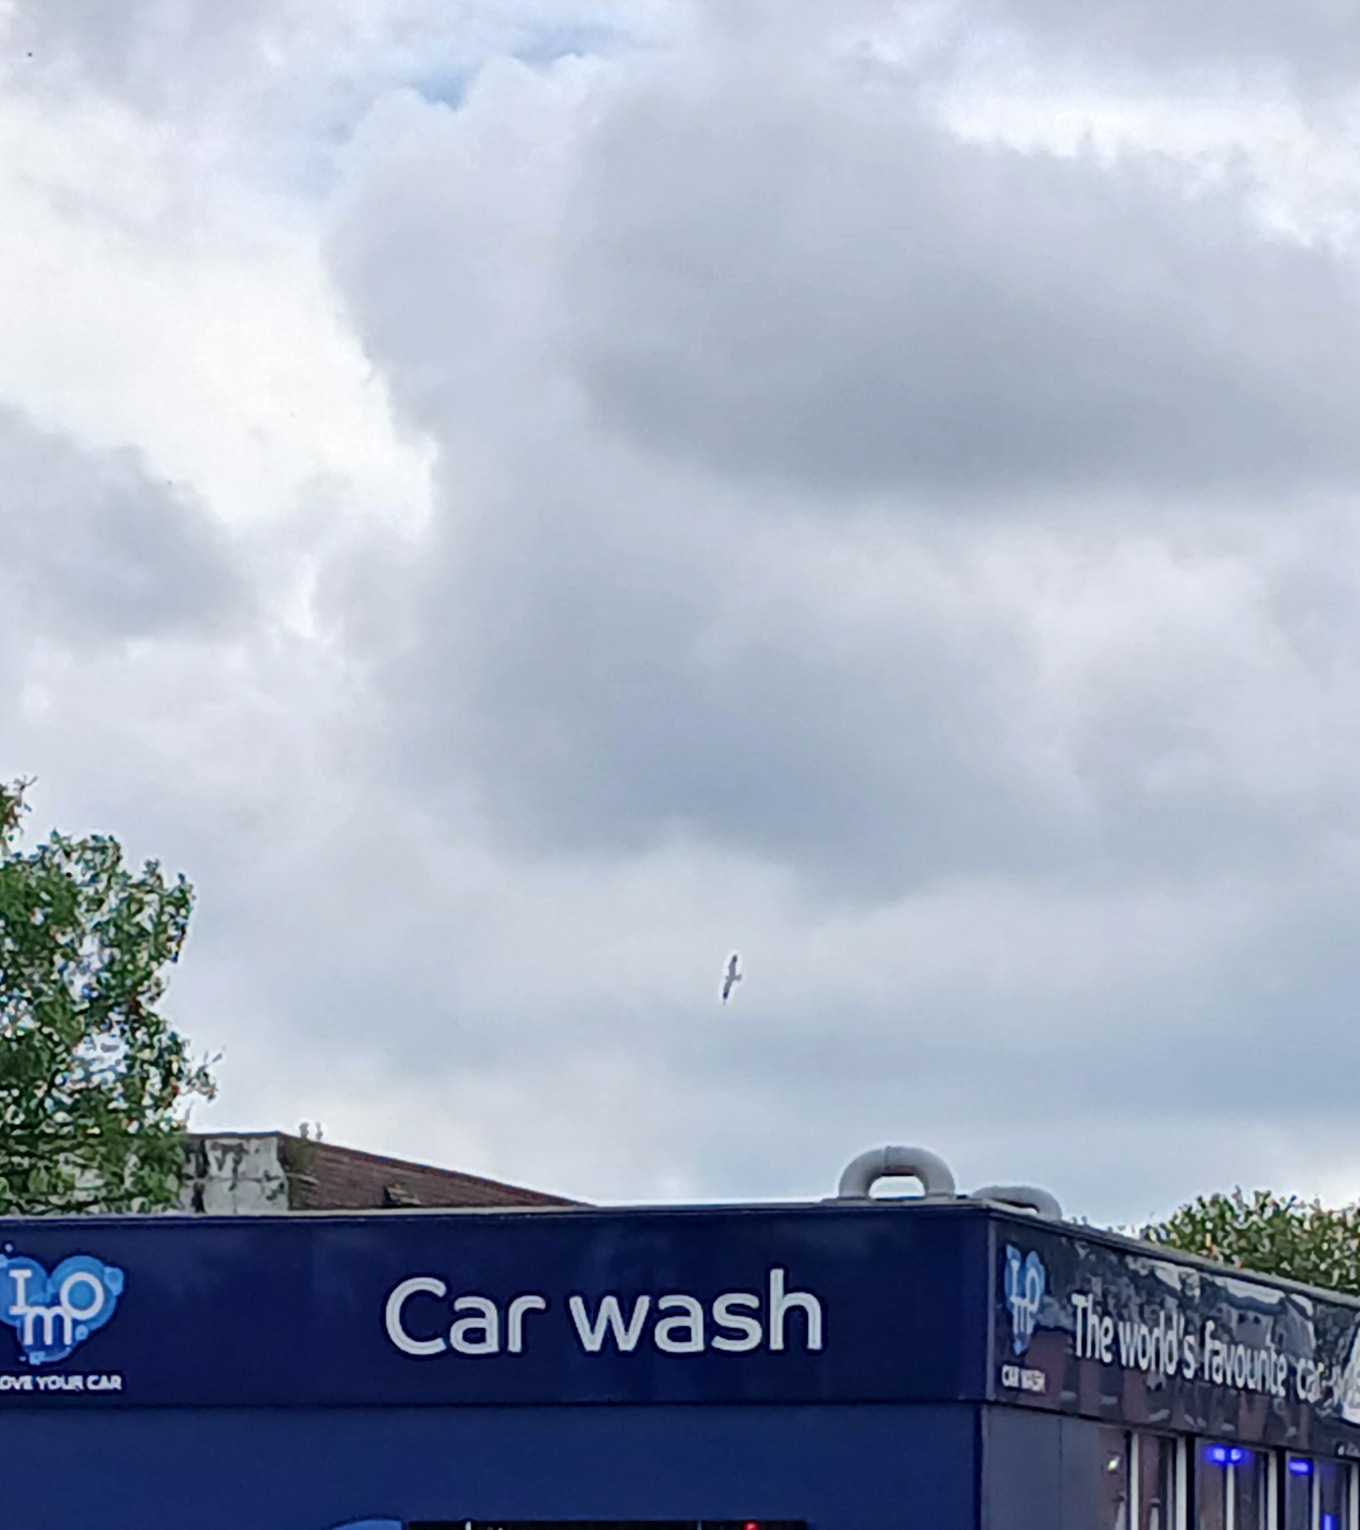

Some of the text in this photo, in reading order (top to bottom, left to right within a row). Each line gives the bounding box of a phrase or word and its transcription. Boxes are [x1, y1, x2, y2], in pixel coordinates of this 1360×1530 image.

[384, 1268, 823, 1355] Car wash
[1071, 1292, 1114, 1363] The
[1118, 1310, 1195, 1379] world's
[1204, 1319, 1288, 1397] favourite
[36, 1374, 85, 1391] YOUR
[86, 1375, 123, 1391] CAR
